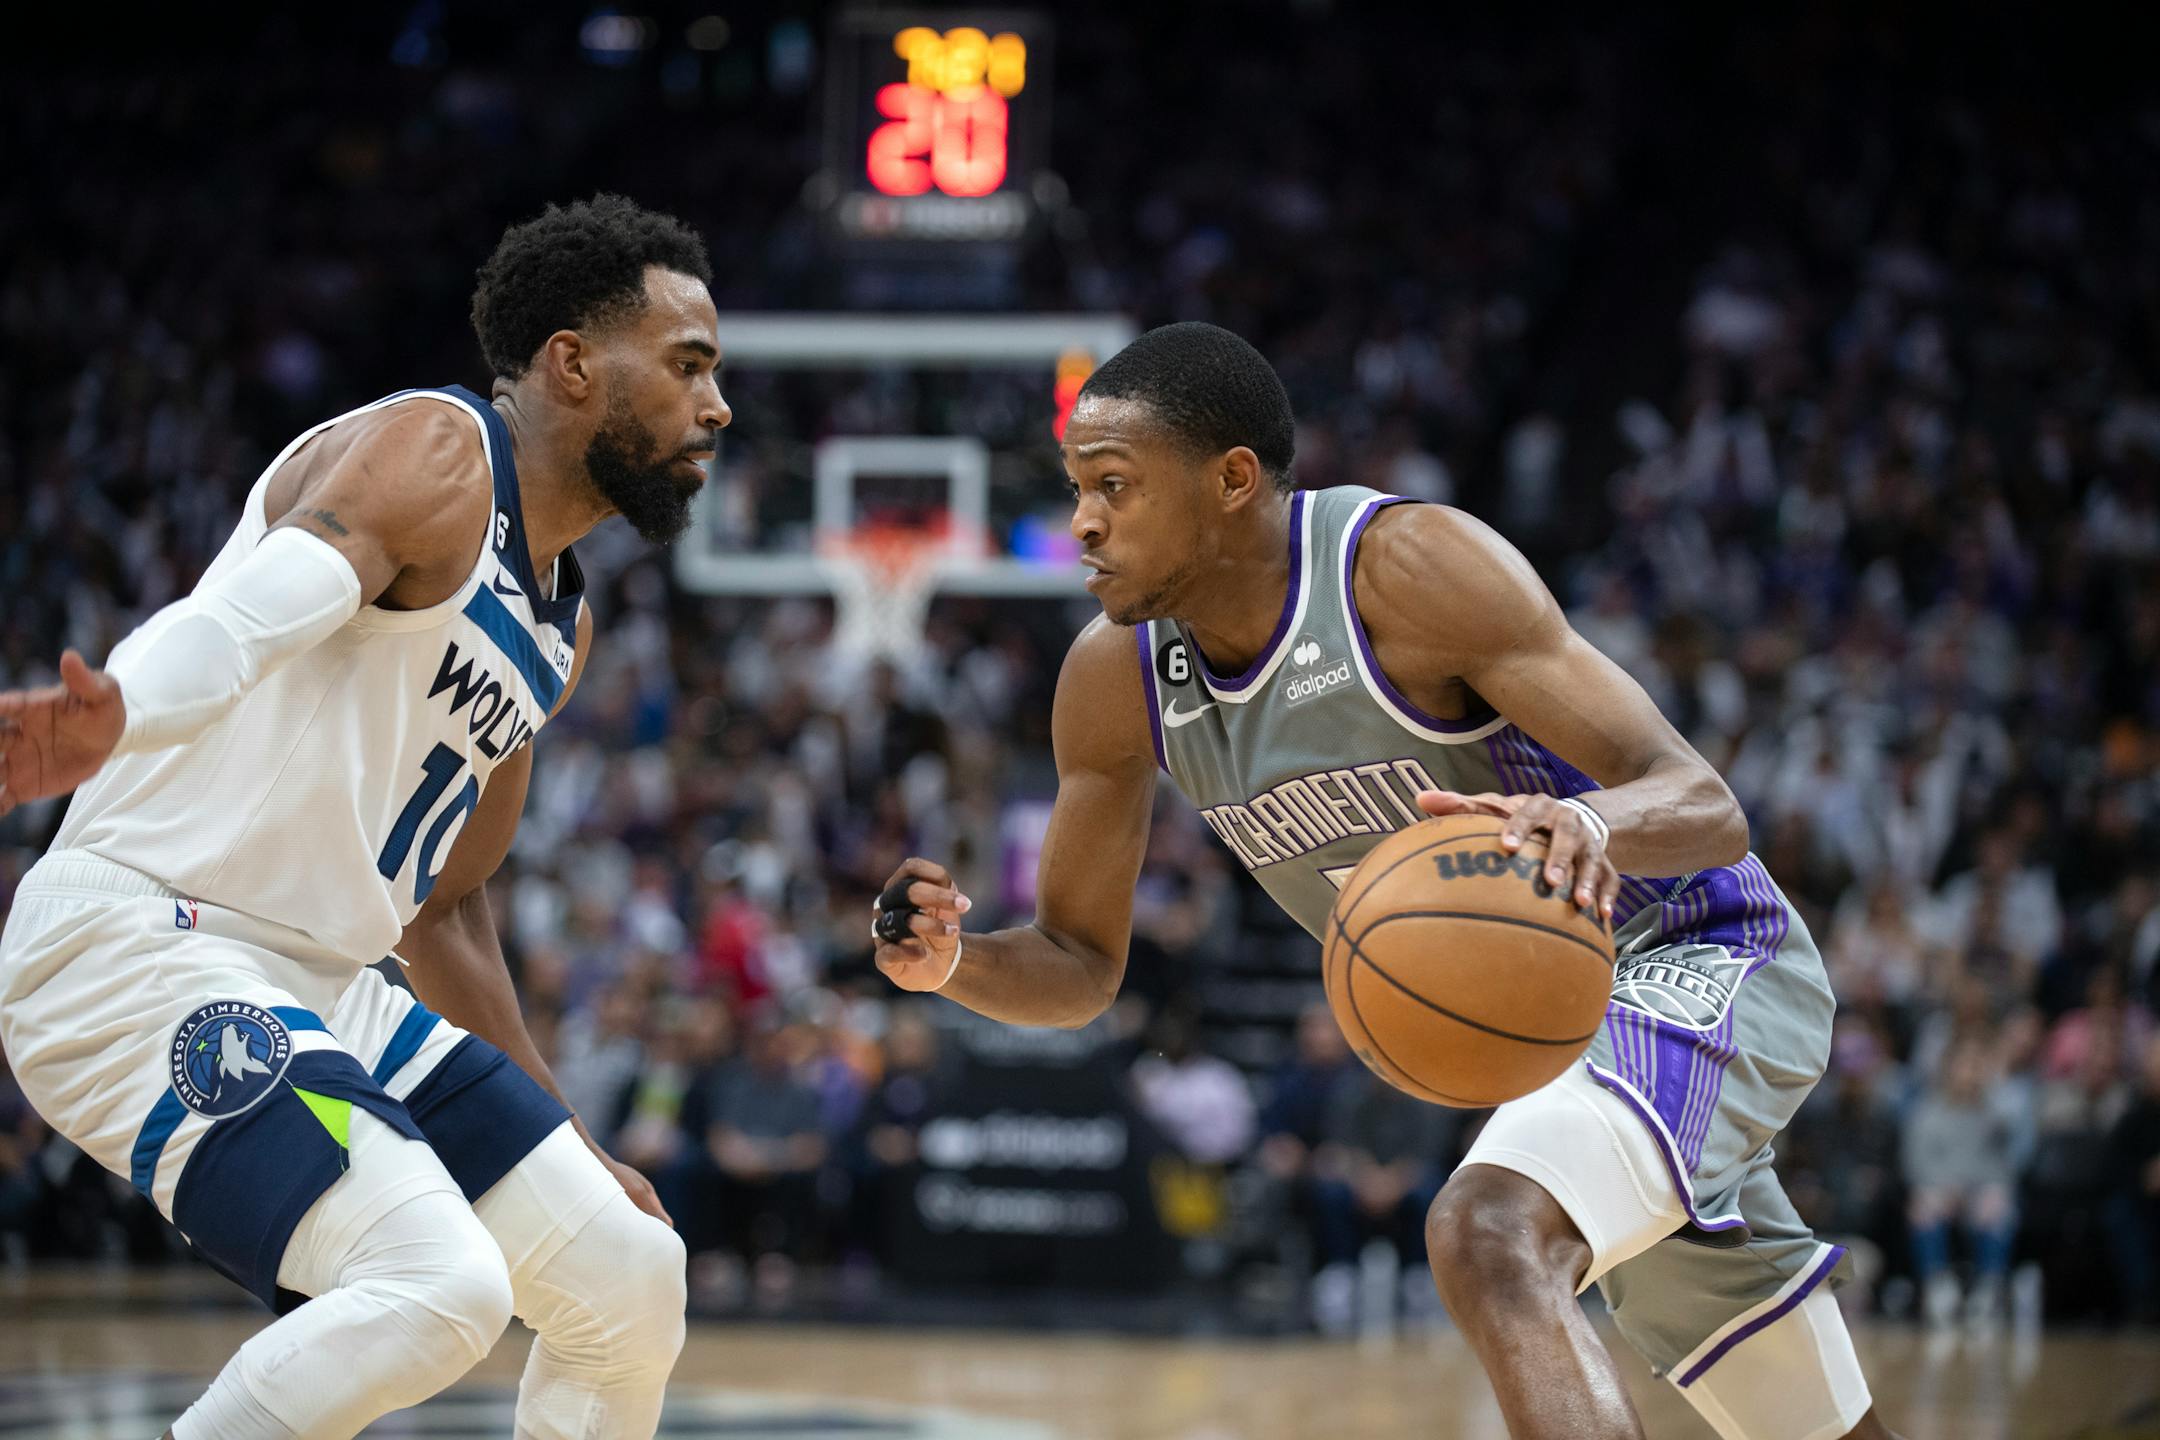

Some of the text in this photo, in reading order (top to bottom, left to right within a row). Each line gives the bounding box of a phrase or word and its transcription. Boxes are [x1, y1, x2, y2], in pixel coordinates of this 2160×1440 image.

[496, 512, 509, 549] 6
[1168, 645, 1189, 681] 6
[1286, 662, 1351, 700] dialpad
[377, 741, 478, 905] 10
[1199, 758, 1440, 872] ACRAMENTO
[174, 1004, 288, 1109] MINNESOTA TIMBERWOLVES
